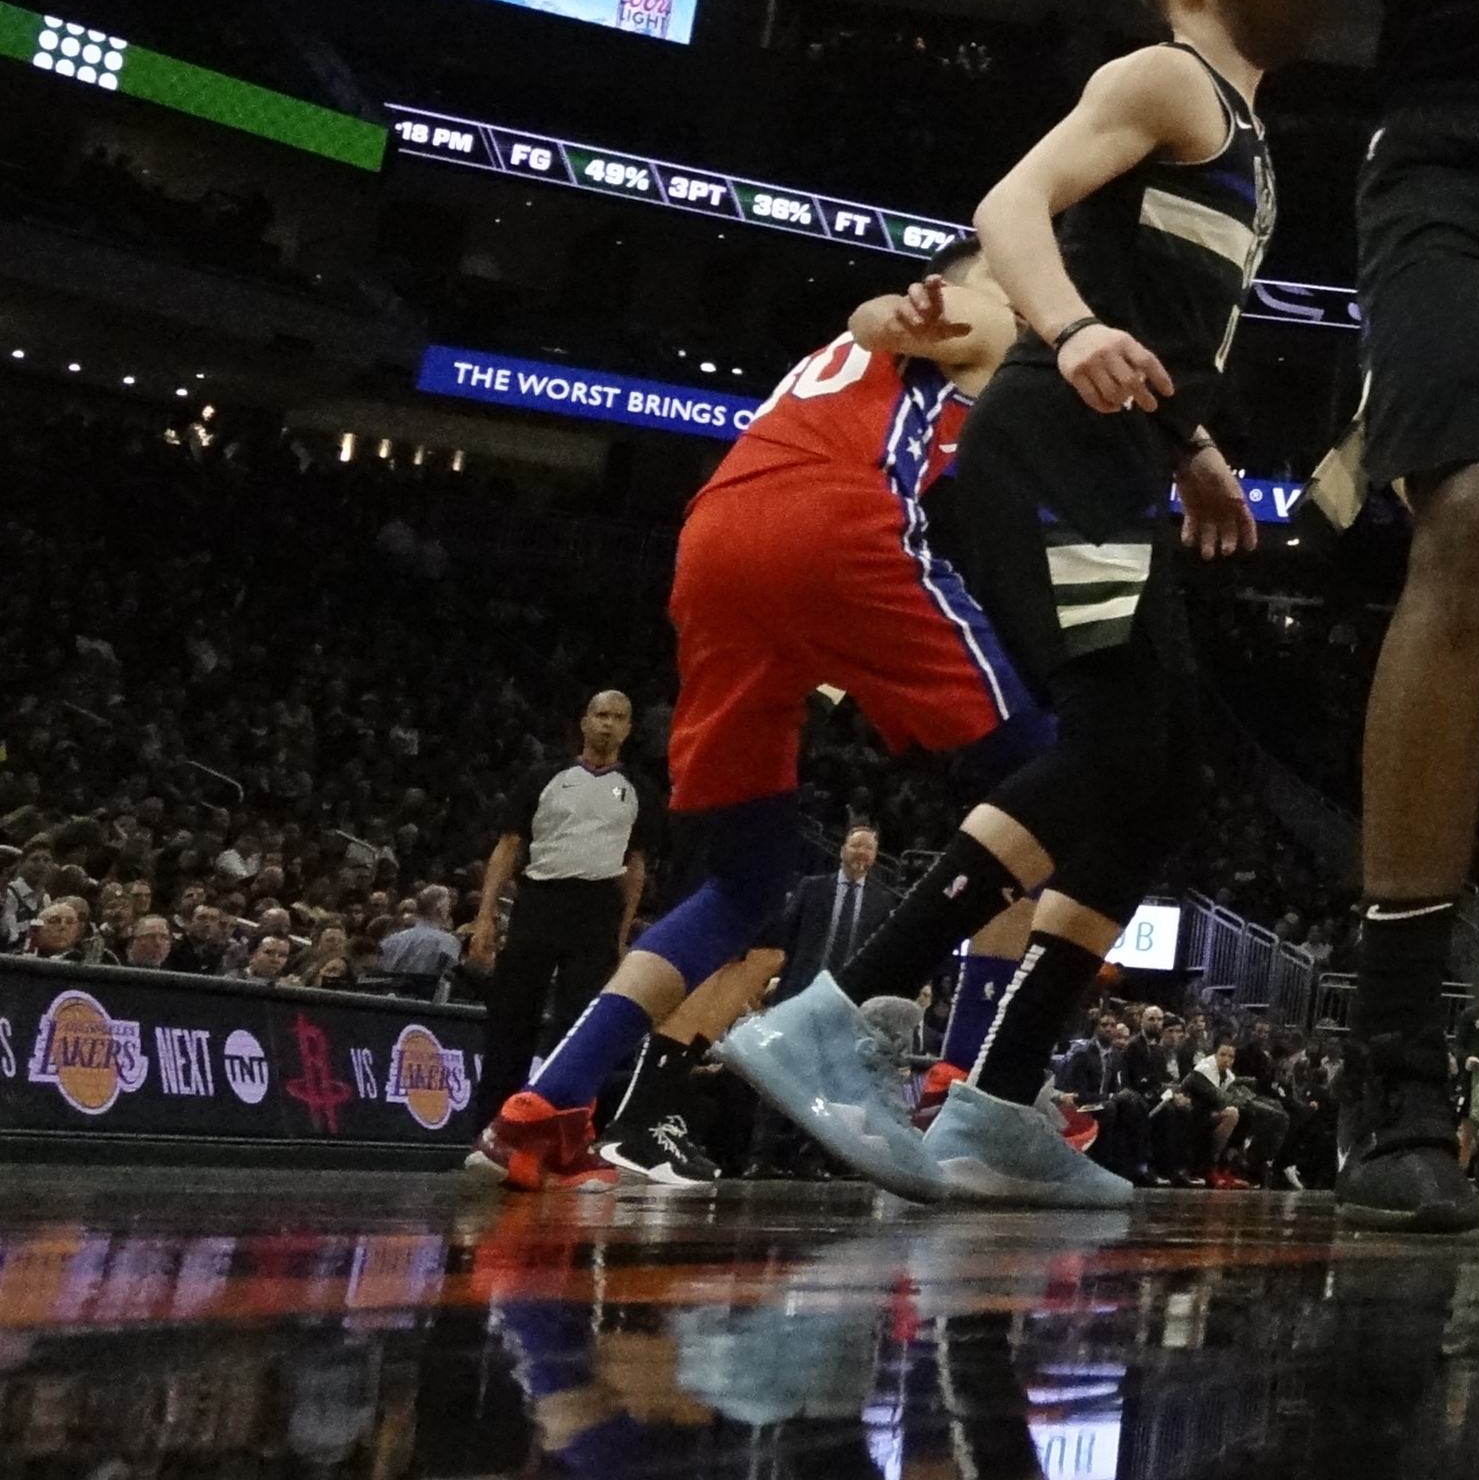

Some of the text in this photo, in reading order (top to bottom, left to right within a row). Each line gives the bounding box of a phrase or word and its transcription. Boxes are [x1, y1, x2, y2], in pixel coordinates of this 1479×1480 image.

[432, 127, 474, 153] PM
[510, 142, 552, 171] FG
[584, 158, 651, 192] 49%
[668, 175, 727, 207] 3PT
[752, 193, 813, 226] 36%
[834, 209, 871, 237] FT
[903, 224, 956, 252] 67%
[453, 361, 511, 391] THE
[516, 371, 622, 410] WORST
[627, 390, 726, 429] BRINGS
[37, 1022, 148, 1086] LAKERS
[155, 1026, 215, 1097] NEXT
[225, 1054, 268, 1085] TNT
[350, 1047, 377, 1099] VS
